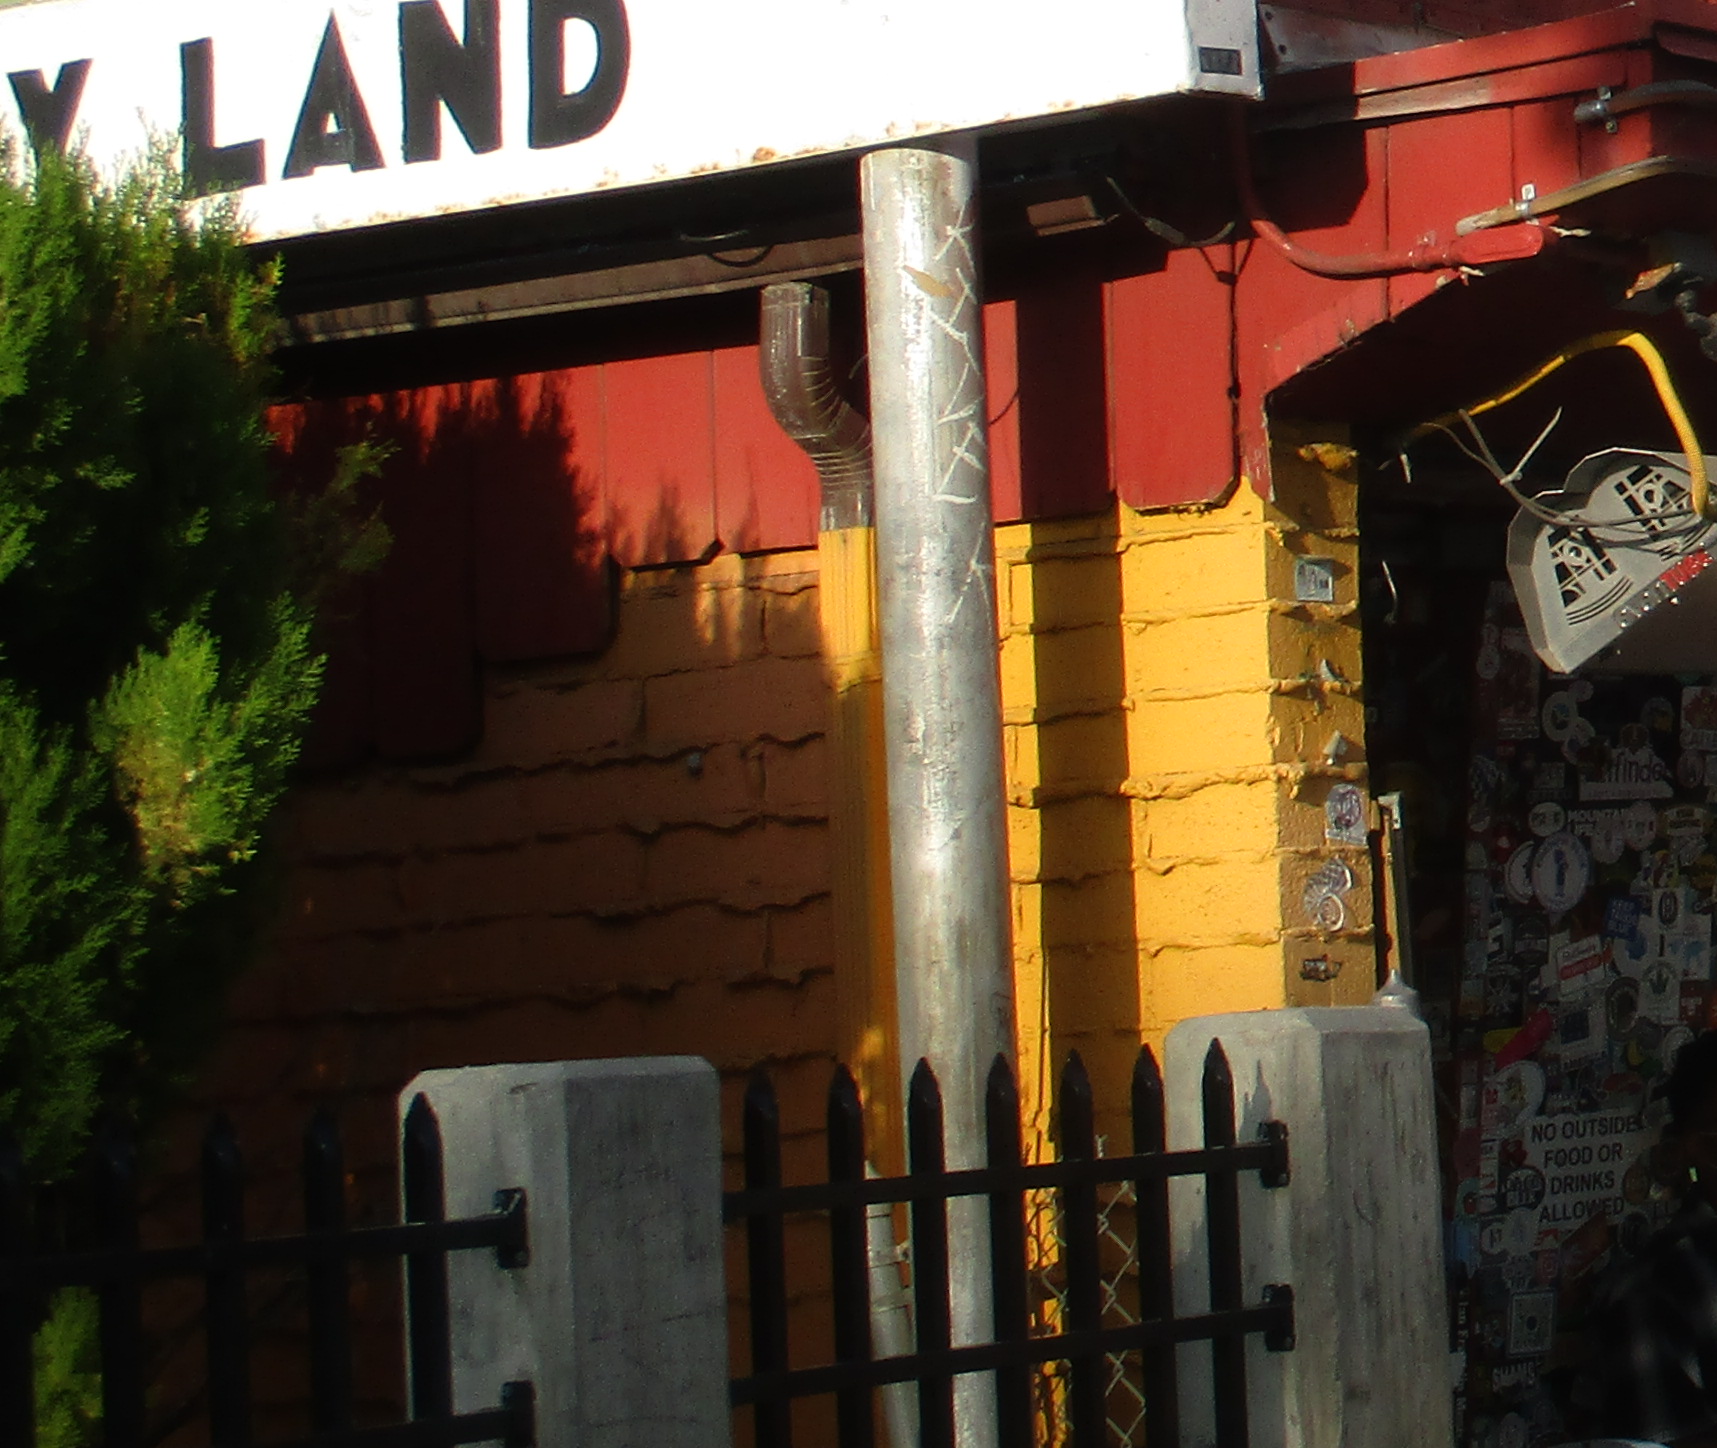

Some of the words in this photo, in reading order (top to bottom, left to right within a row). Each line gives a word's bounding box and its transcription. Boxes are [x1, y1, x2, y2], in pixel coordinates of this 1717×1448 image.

[1532, 1123, 1556, 1144] NO
[1562, 1116, 1641, 1138] OUTSIDE
[1544, 1147, 1594, 1168] FOOD
[1597, 1142, 1624, 1163] OR
[1551, 1170, 1615, 1195] DRINKS
[1539, 1197, 1625, 1223] ALLOWED
